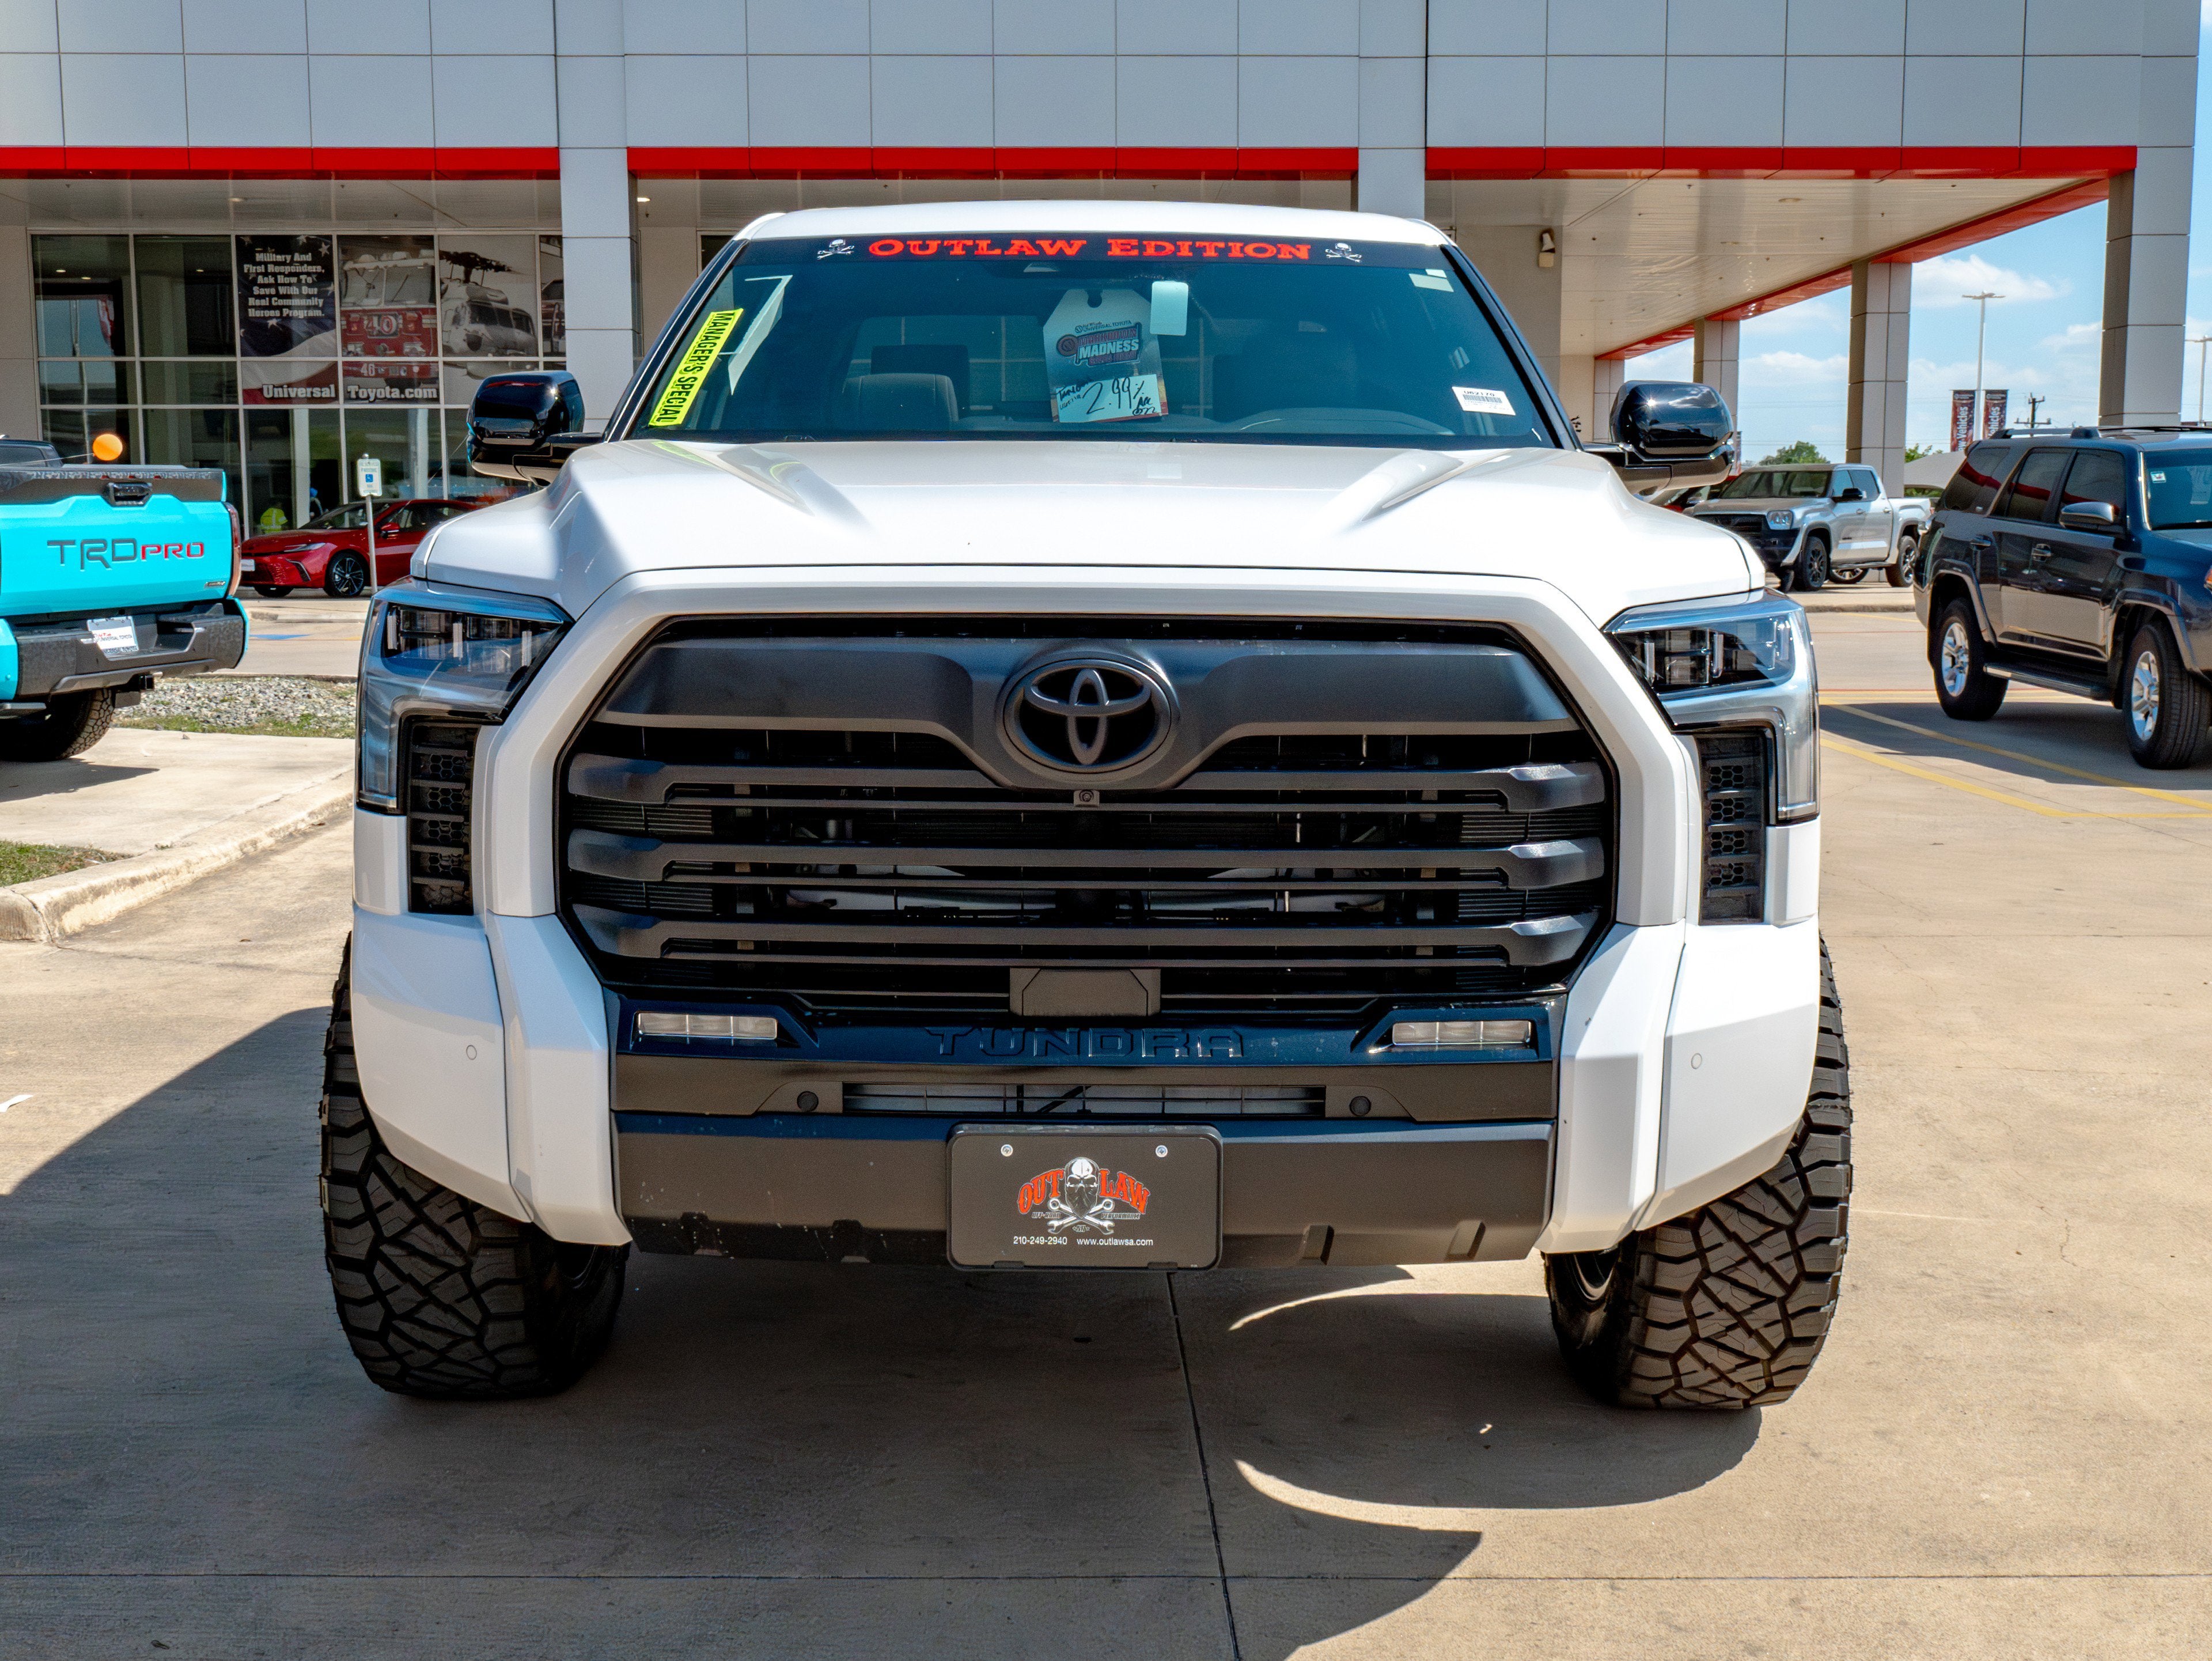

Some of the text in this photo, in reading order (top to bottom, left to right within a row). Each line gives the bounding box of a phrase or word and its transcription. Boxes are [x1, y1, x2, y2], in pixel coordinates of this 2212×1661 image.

[255, 252, 312, 263] Military And
[868, 238, 1311, 260] OUTLAW EDITION
[244, 264, 325, 274] First Responders,
[257, 274, 313, 283] Ask How To
[252, 286, 318, 295] Save With Our
[248, 297, 324, 307] Real Community
[248, 308, 325, 319] Heroes Program.
[1079, 339, 1139, 360] MADNESS
[656, 313, 735, 422] MANAGER'S SPECIAL
[263, 384, 438, 402] Universal Toyota.com
[1956, 406, 1968, 439] Vehicles
[47, 538, 204, 570] TRD PRO
[925, 1027, 1245, 1057] TUNDRA
[1017, 1168, 1151, 1214] OUT LAW
[1013, 1236, 1153, 1246] 210-249-2940 www.outlawsa.com
